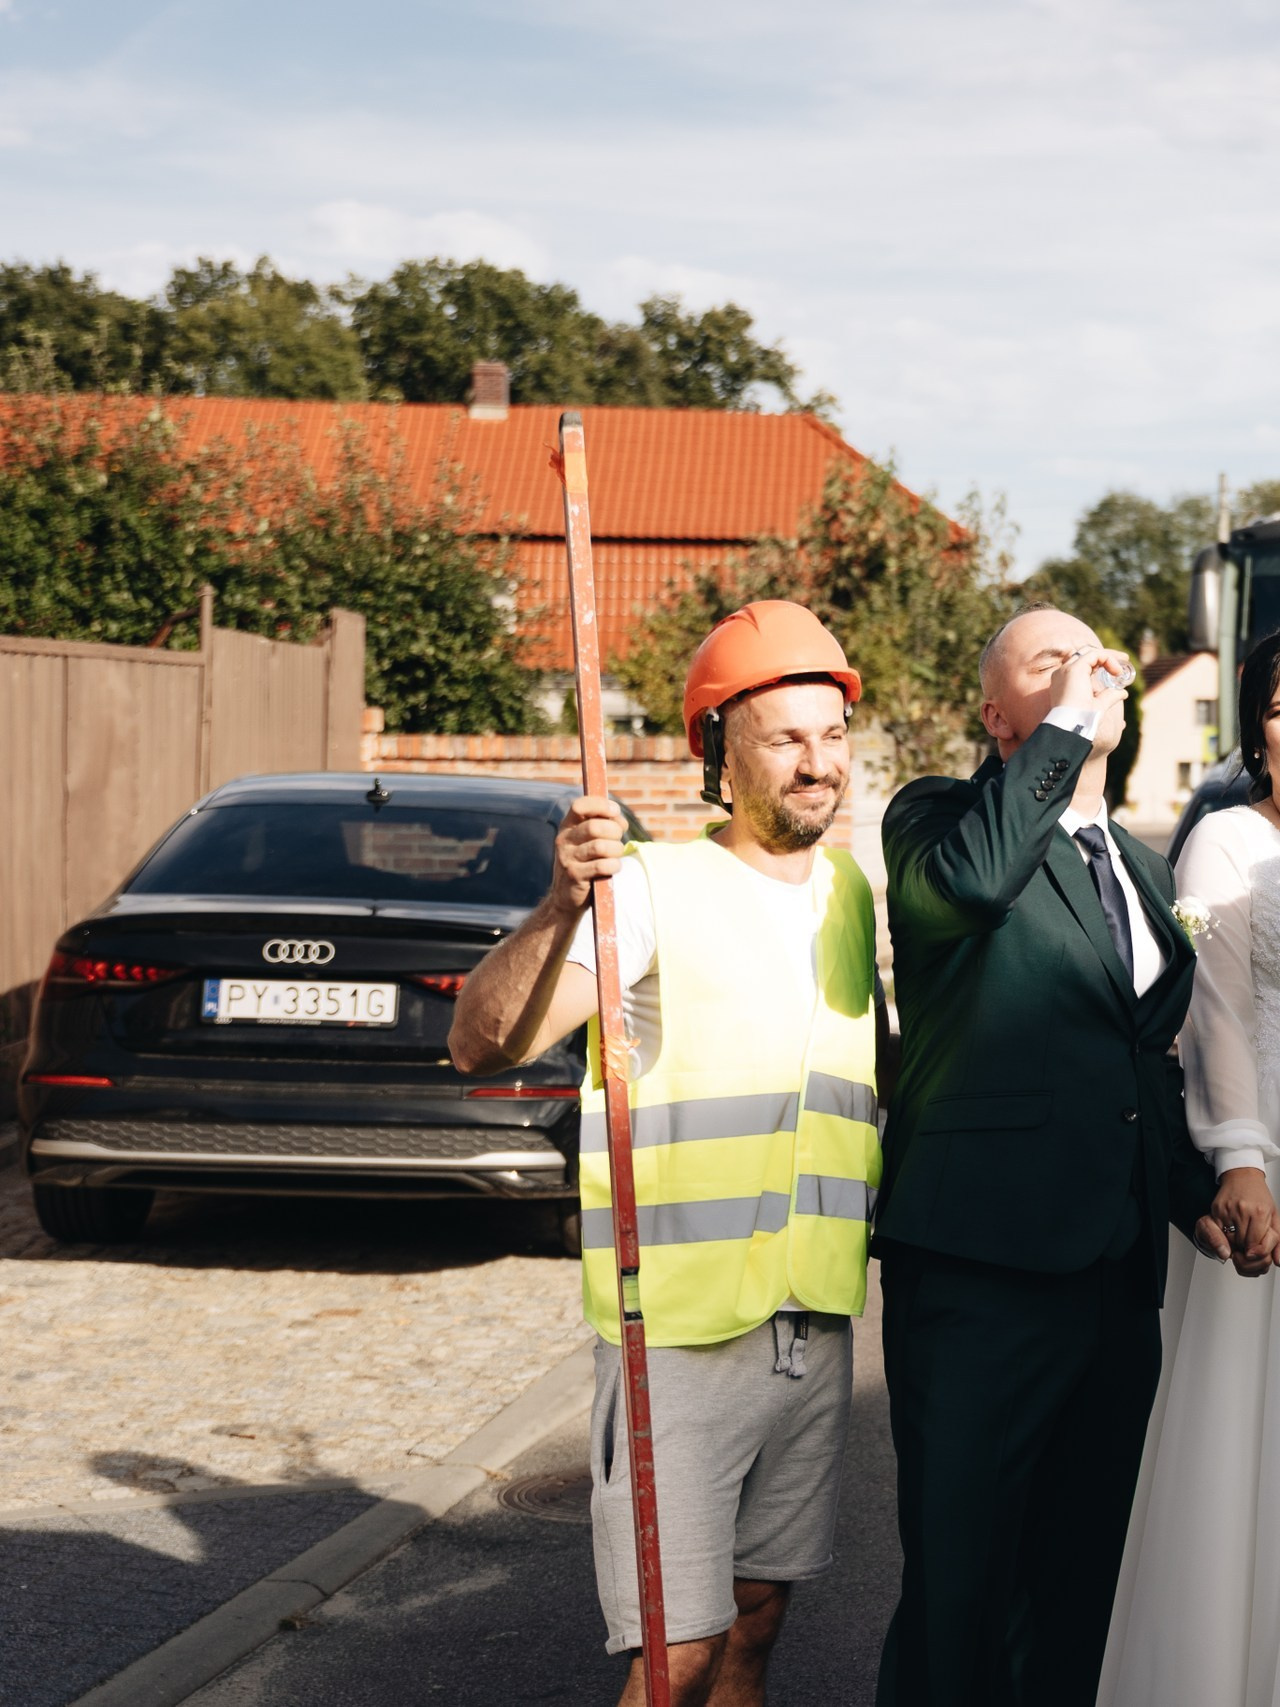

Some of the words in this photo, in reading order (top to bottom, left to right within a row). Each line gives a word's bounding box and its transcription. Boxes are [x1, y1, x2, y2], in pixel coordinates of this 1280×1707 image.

[204, 1001, 219, 1013] PL
[227, 984, 269, 1013] PY
[284, 986, 384, 1017] 3351G
